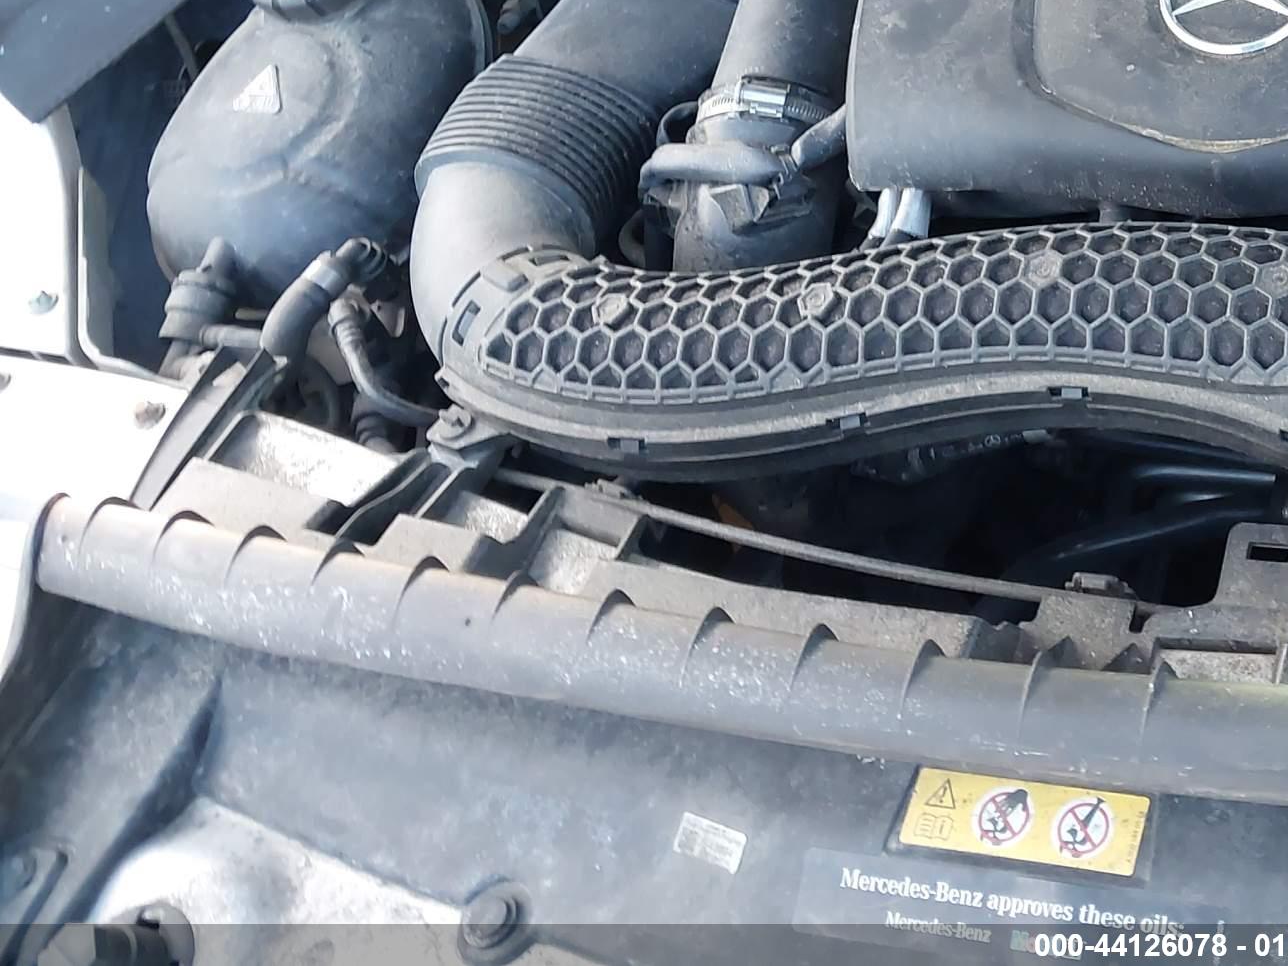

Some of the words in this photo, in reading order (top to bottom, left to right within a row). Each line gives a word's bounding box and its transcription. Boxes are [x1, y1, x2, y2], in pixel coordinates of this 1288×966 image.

[839, 867, 983, 908] Mercedes-Benz
[986, 893, 1075, 922] approves
[1079, 903, 1136, 931] these
[885, 910, 992, 944] Mercedes-Benz
